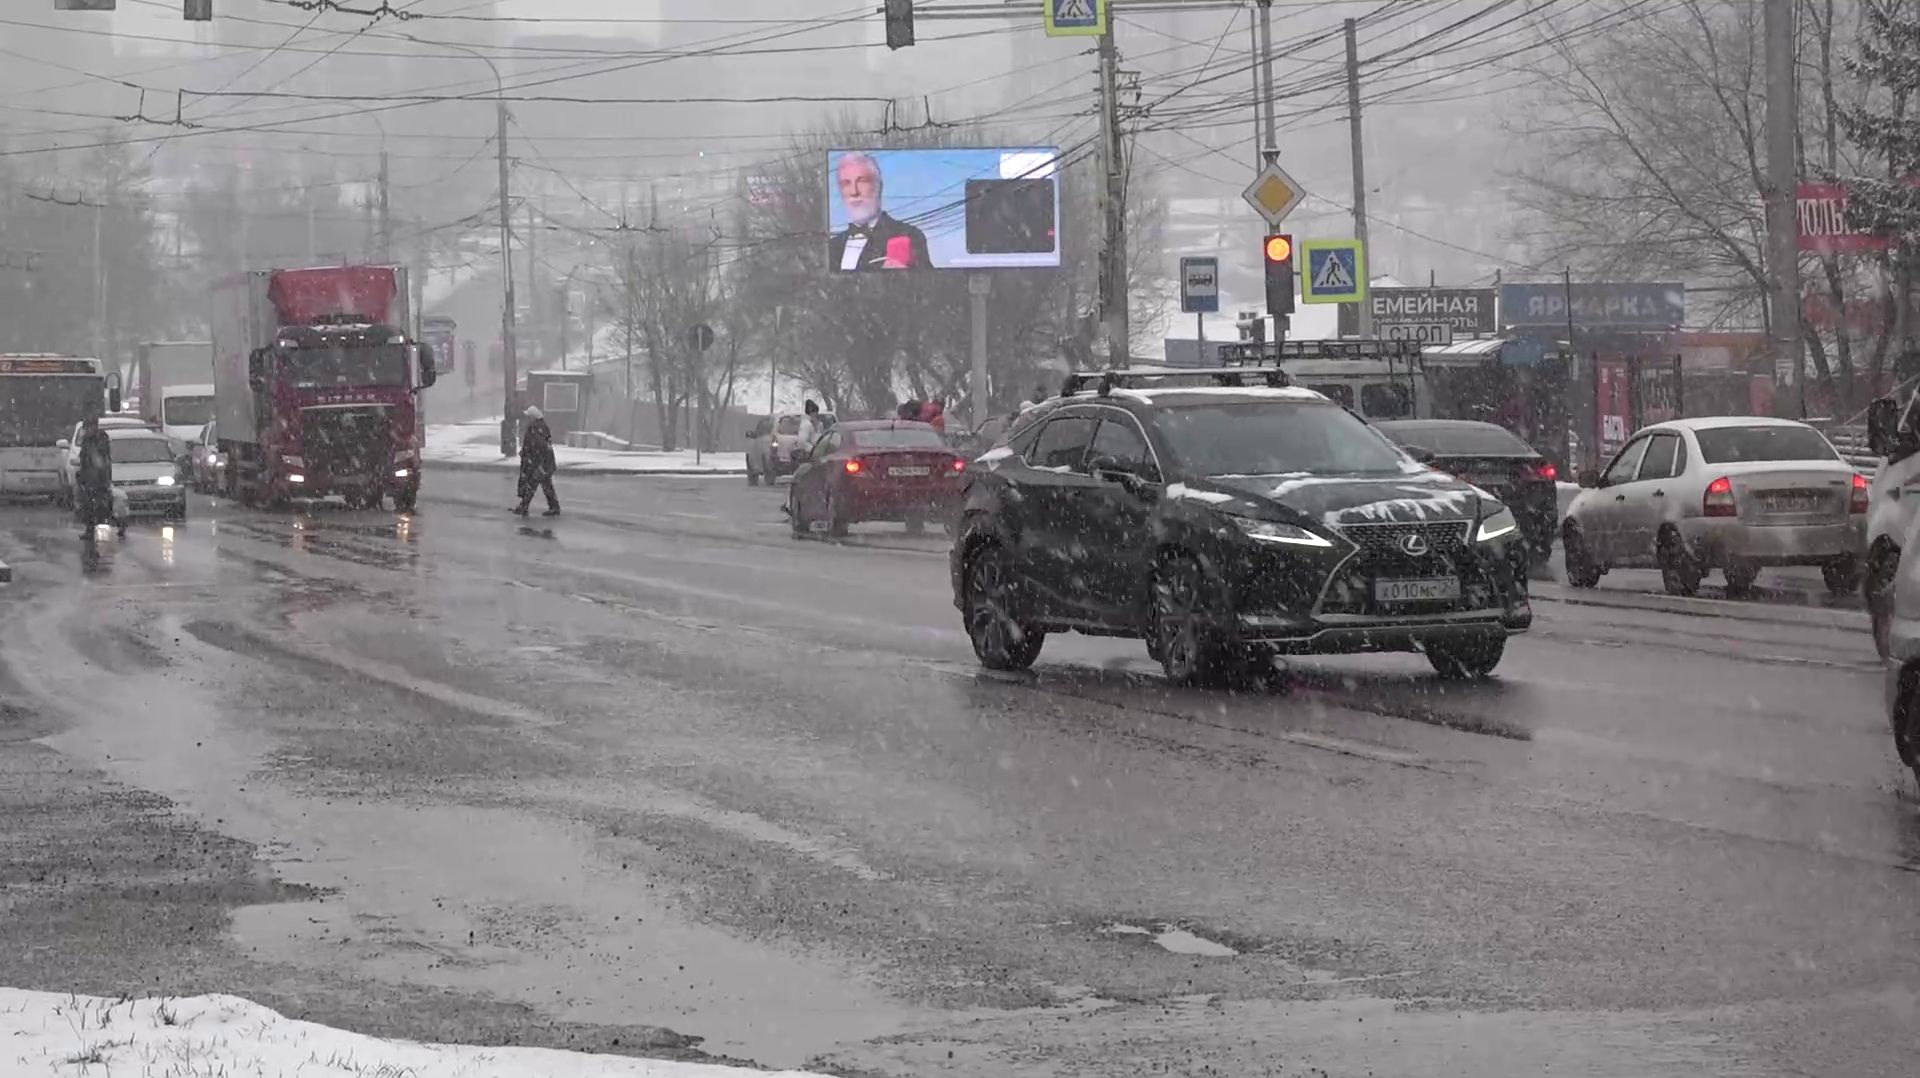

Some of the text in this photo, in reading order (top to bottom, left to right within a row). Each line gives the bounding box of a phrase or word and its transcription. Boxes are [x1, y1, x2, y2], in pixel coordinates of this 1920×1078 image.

[1372, 294, 1478, 315] ЕМЕЙНАЯ
[1527, 296, 1657, 317] ЯРМАРКА
[1389, 325, 1443, 343] СТОП
